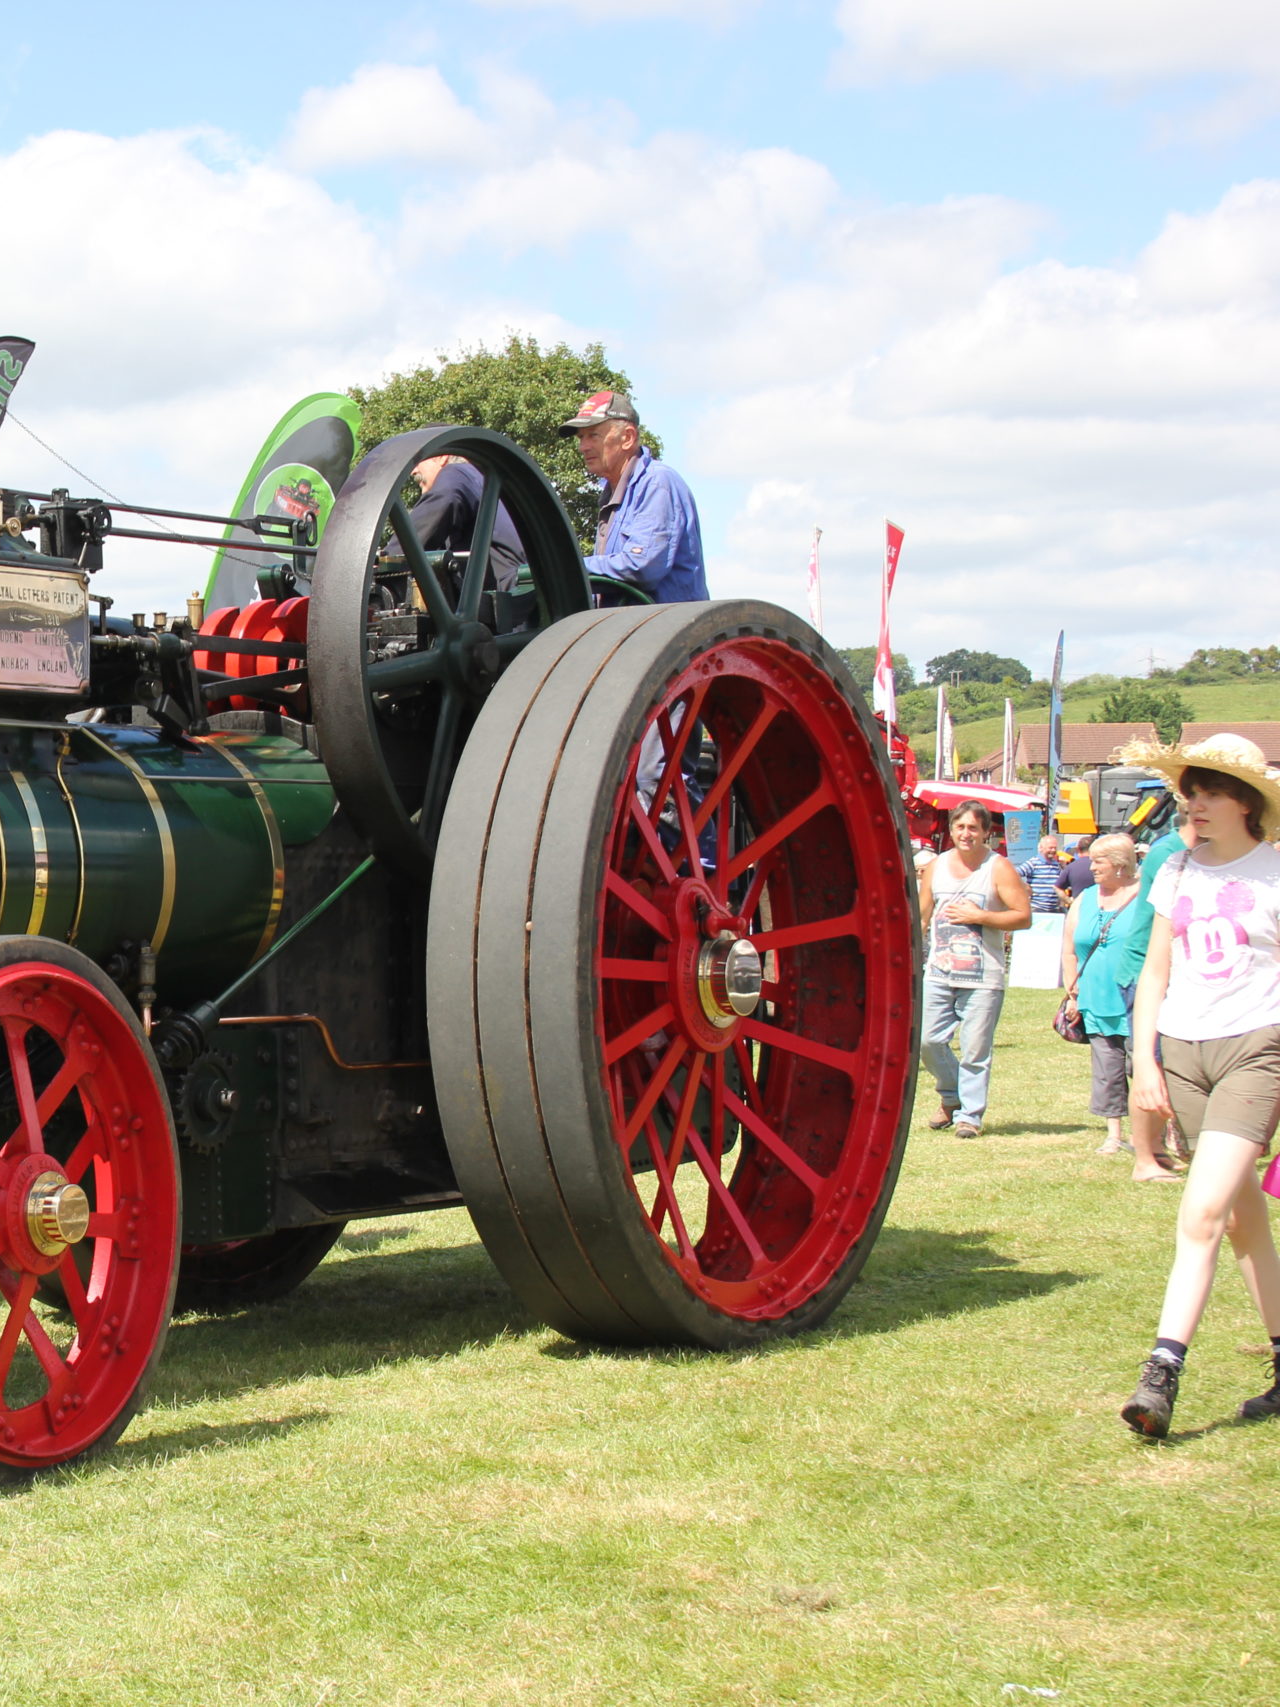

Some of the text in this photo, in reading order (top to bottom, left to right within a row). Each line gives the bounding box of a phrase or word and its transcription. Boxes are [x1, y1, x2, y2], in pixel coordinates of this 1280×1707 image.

[17, 587, 49, 603] LETTERS
[53, 591, 79, 606] PATENT
[34, 630, 65, 647] LIMITED
[37, 657, 68, 674] ENGLAND
